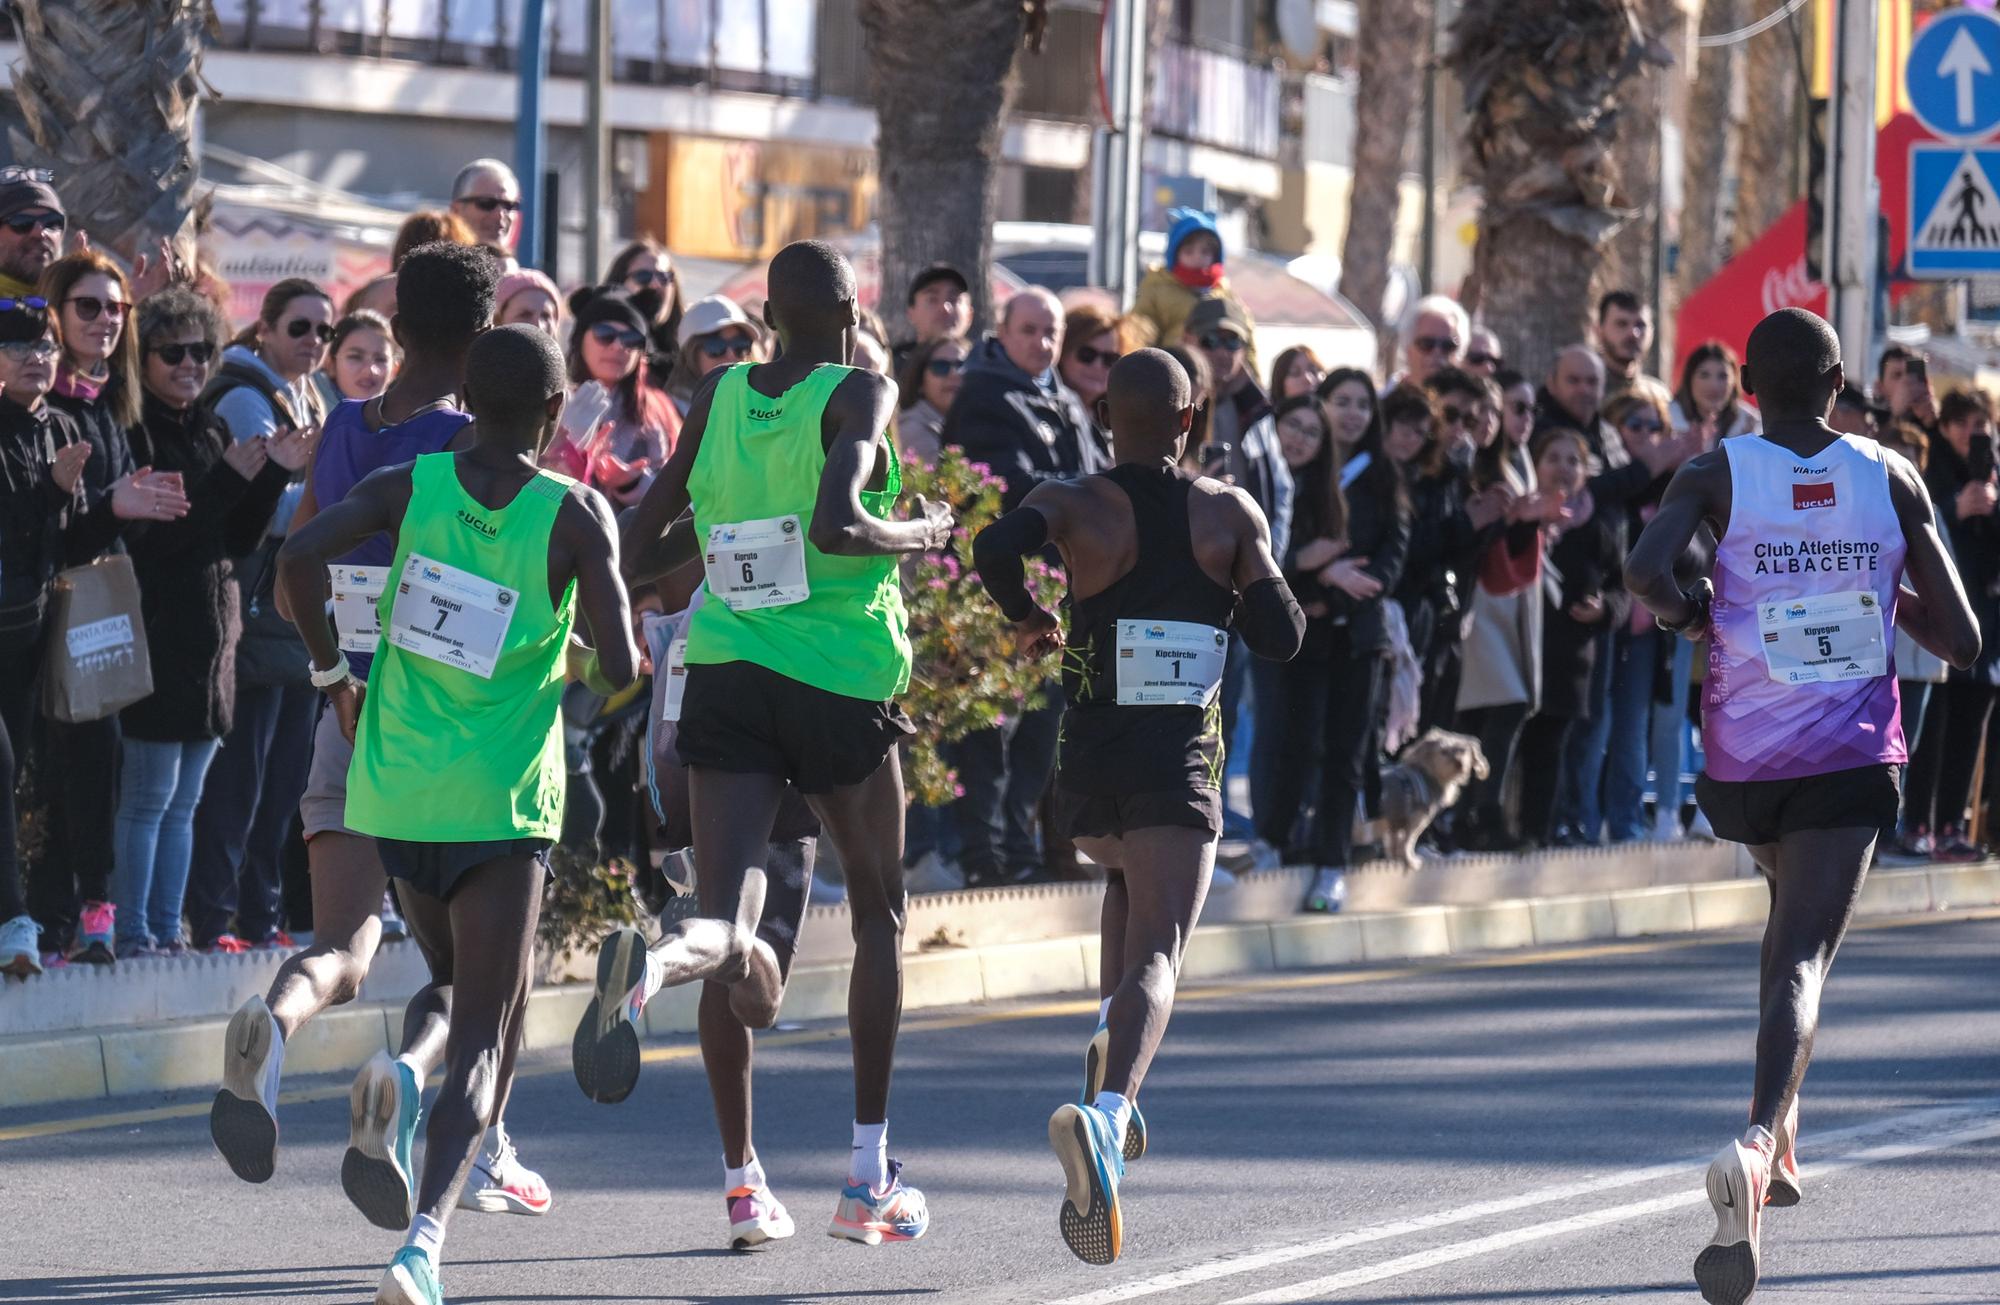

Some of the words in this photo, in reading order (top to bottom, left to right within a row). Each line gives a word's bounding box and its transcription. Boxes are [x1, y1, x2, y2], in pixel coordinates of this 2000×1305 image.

[1793, 466, 1828, 475] VIATOR
[1803, 498, 1834, 509] UCLM
[465, 513, 497, 537] UCLM
[734, 552, 758, 562] Kipruto
[1754, 542, 1795, 558] Club
[1798, 539, 1879, 556] Atletismo
[742, 562, 754, 584] 6
[1755, 556, 1877, 574] ALBACETE
[430, 594, 463, 614] Kipkirui
[434, 608, 449, 631] 7
[1803, 625, 1840, 636] Kipyegon
[1155, 650, 1198, 660] Kipchirchir
[1818, 635, 1832, 657] 5
[1171, 660, 1180, 679] 1
